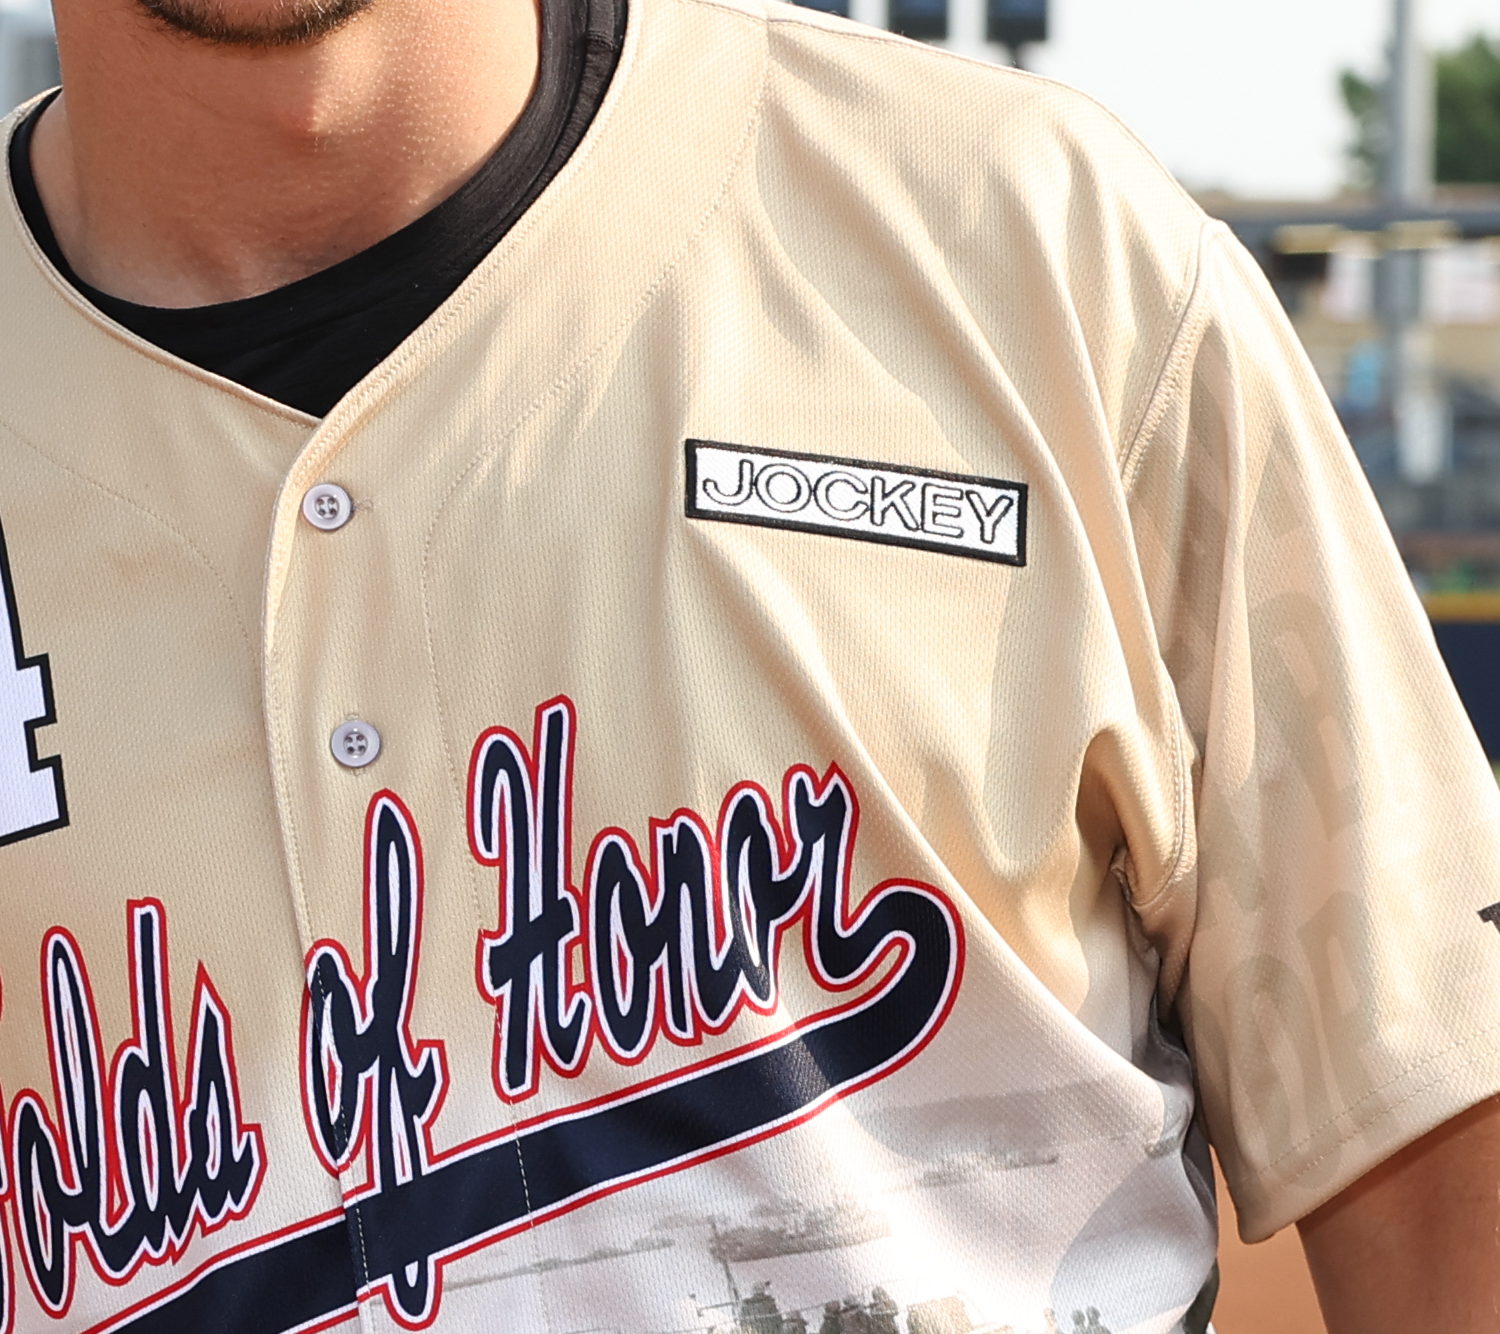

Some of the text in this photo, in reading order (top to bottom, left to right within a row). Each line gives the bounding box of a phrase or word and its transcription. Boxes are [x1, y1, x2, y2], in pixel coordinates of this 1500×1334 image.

[703, 459, 1014, 544] JOCKEY
[300, 788, 448, 1328] of
[467, 694, 875, 1103] Honor
